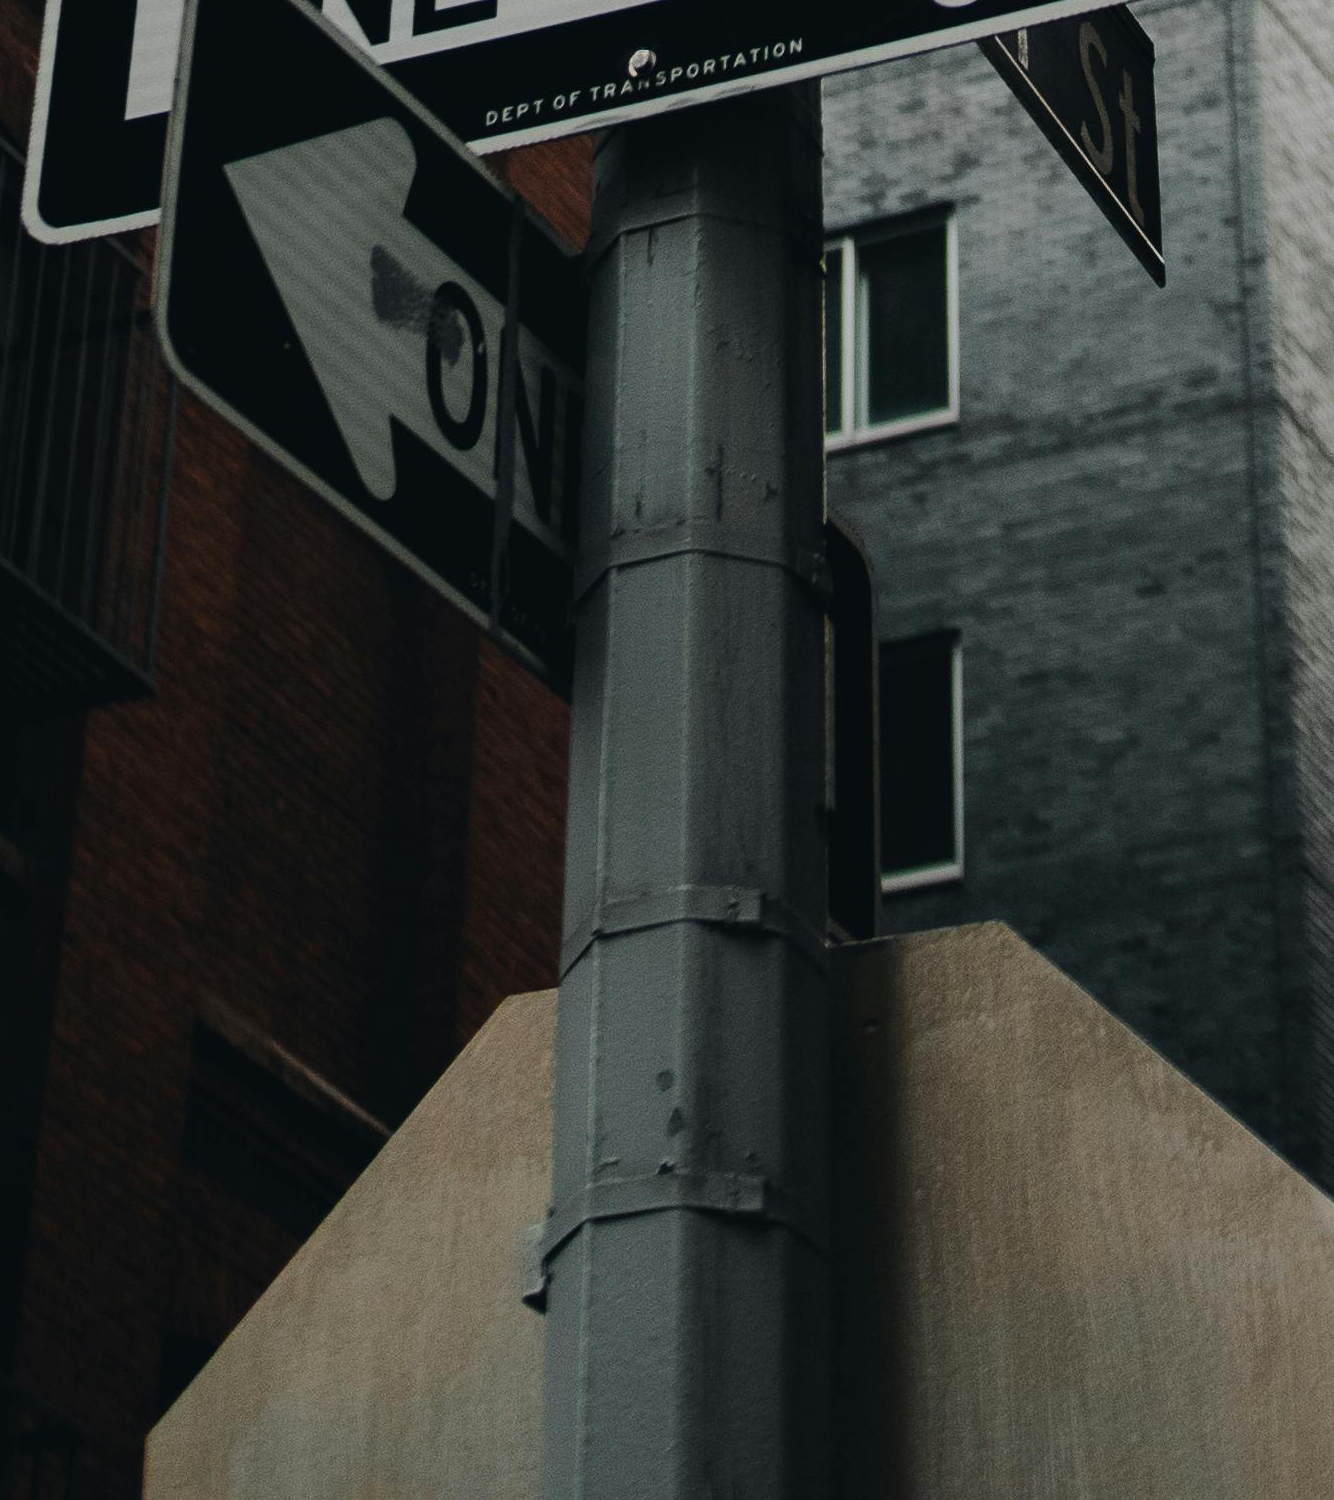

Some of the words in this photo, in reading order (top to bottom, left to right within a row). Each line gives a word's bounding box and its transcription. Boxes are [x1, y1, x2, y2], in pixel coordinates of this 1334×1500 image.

[484, 100, 544, 127] DEPT
[552, 90, 582, 112] OF
[588, 37, 805, 102] TRANSPORTATION
[1078, 21, 1145, 228] St
